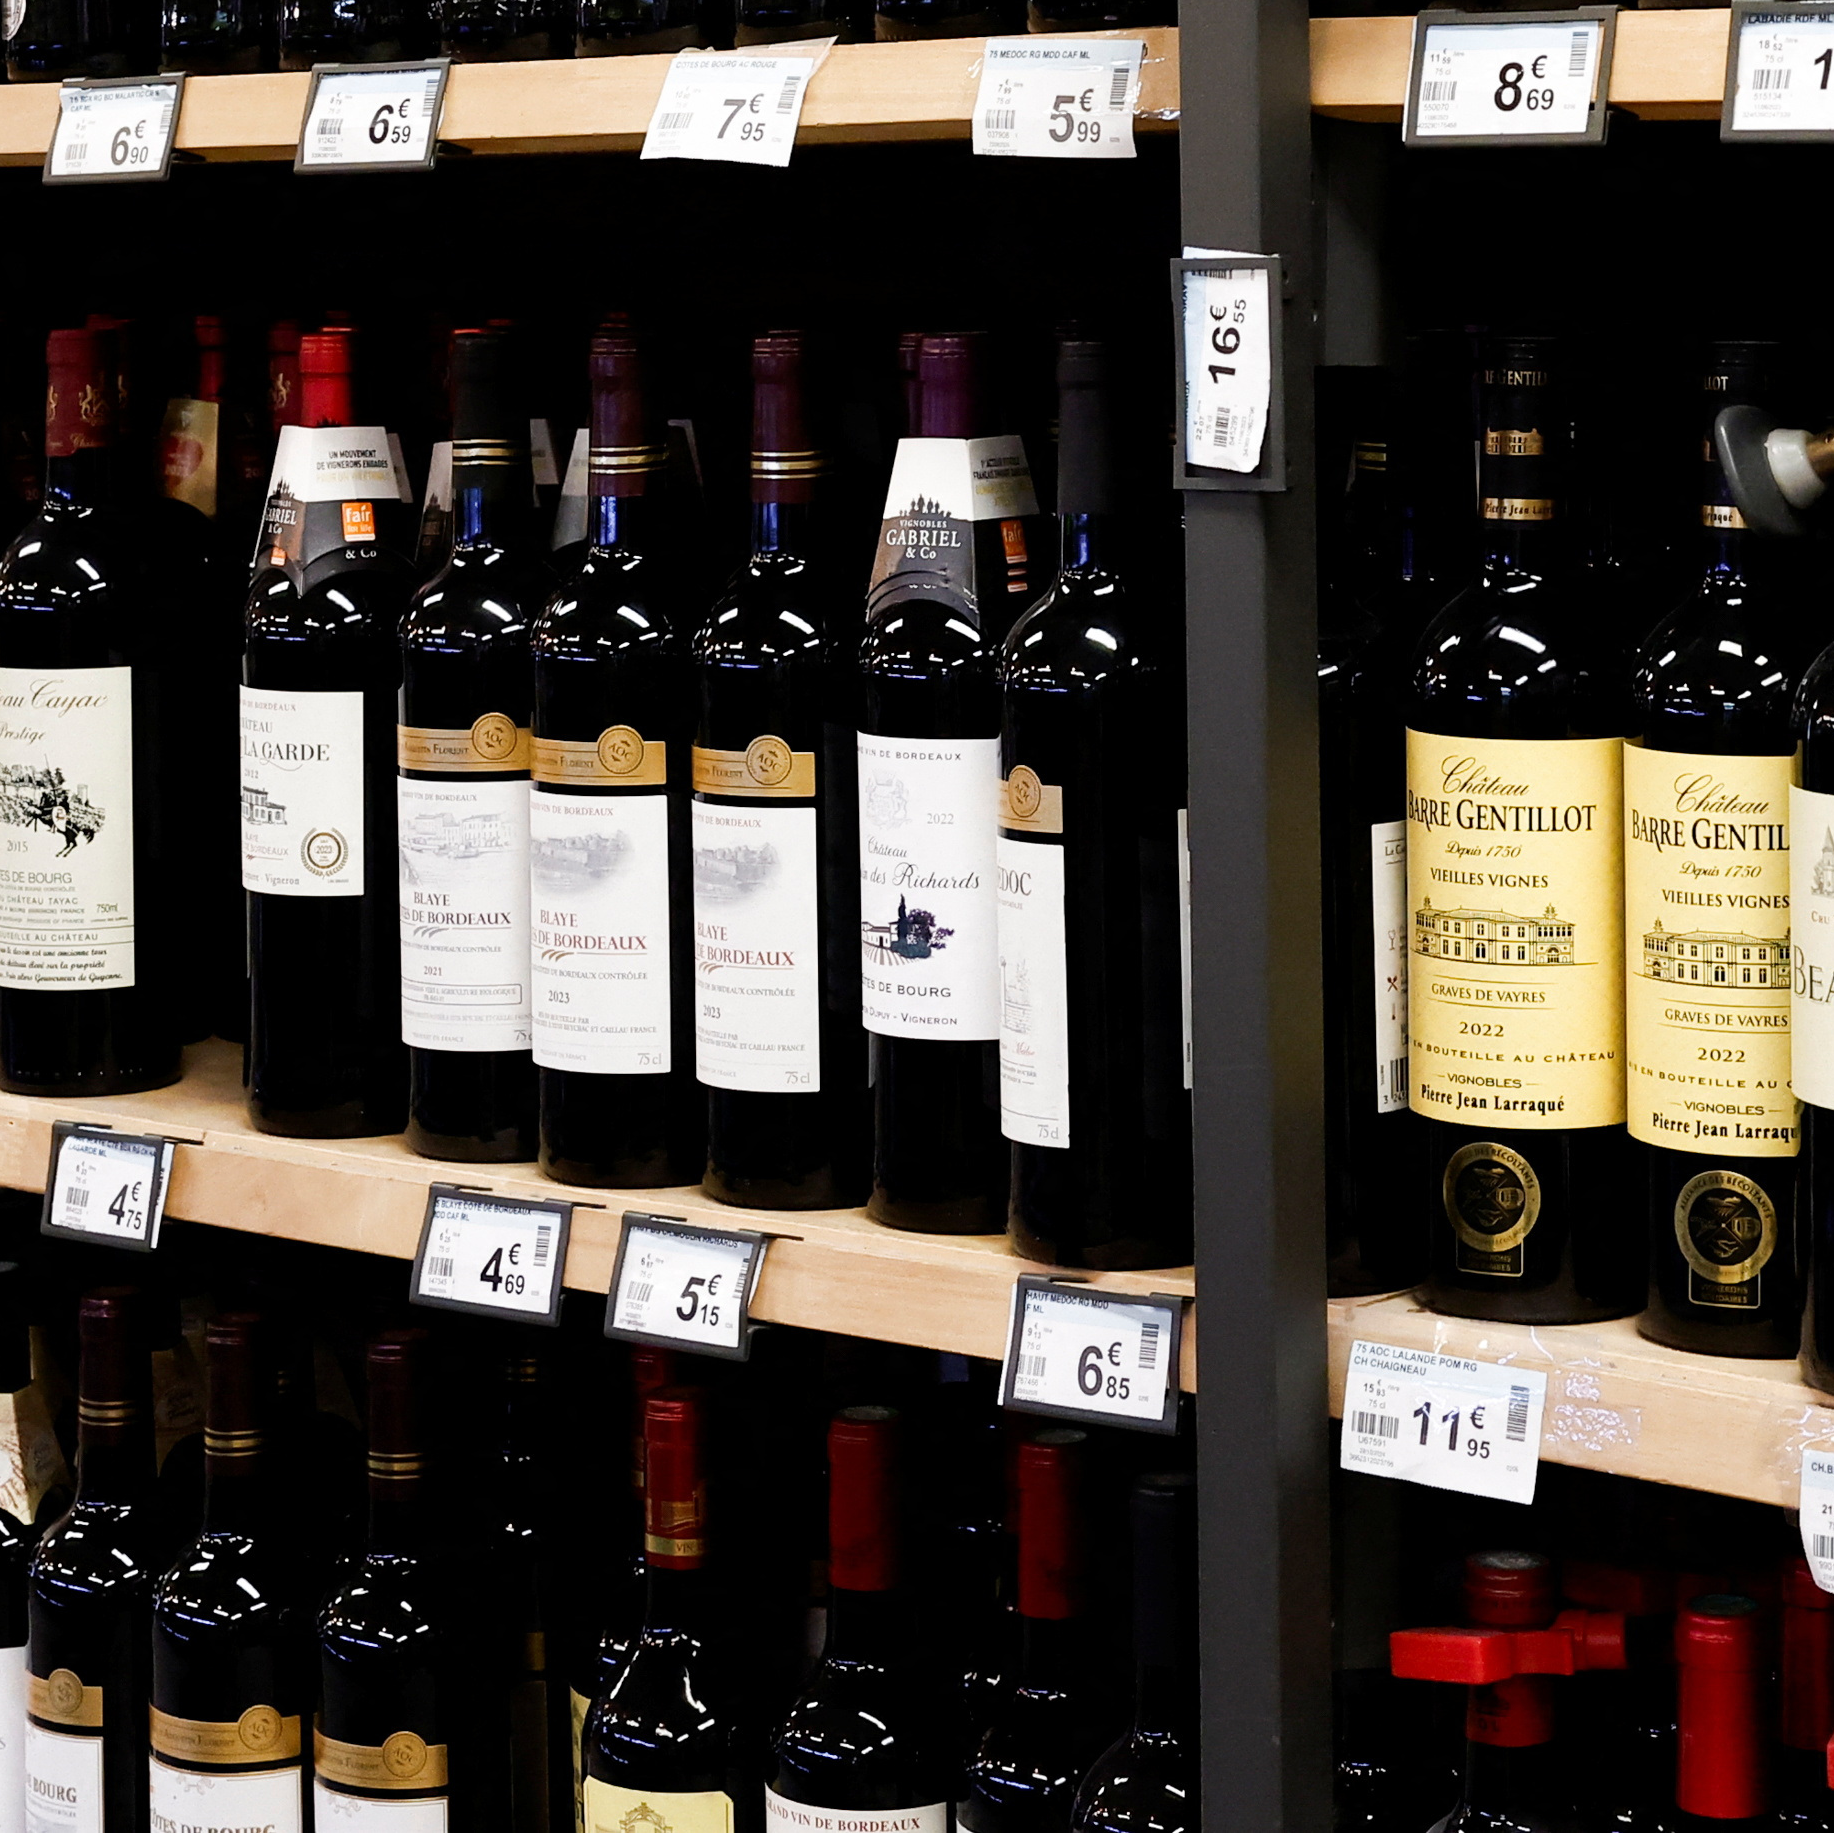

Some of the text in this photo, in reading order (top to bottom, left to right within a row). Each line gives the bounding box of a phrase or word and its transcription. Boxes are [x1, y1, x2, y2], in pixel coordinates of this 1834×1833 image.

[989, 50, 1090, 59] 75 MEDOC RG MDD CAF ML
[886, 527, 961, 548] GABRIEL
[261, 742, 330, 764] GARDE
[896, 751, 962, 762] BORDEAUX
[1408, 791, 1596, 833] BARRE GENTILLOT
[1632, 810, 1685, 852] BARRE
[1431, 867, 1548, 888] VIEILLES VIGNES
[427, 909, 511, 925] BORDEAUX
[1811, 910, 1831, 924] CRU
[553, 933, 647, 950] BORDEAUX
[707, 948, 795, 965] BORDEAUX
[548, 990, 570, 1003] 2023
[901, 1014, 958, 1026] VIGNERON
[1459, 1022, 1505, 1037] 2022
[1698, 1048, 1746, 1063] 2022
[1447, 1072, 1522, 1088] VIGNOBLES
[32, 1783, 77, 1804] BOURG
[816, 1816, 921, 1833] DE BORDEAUX
